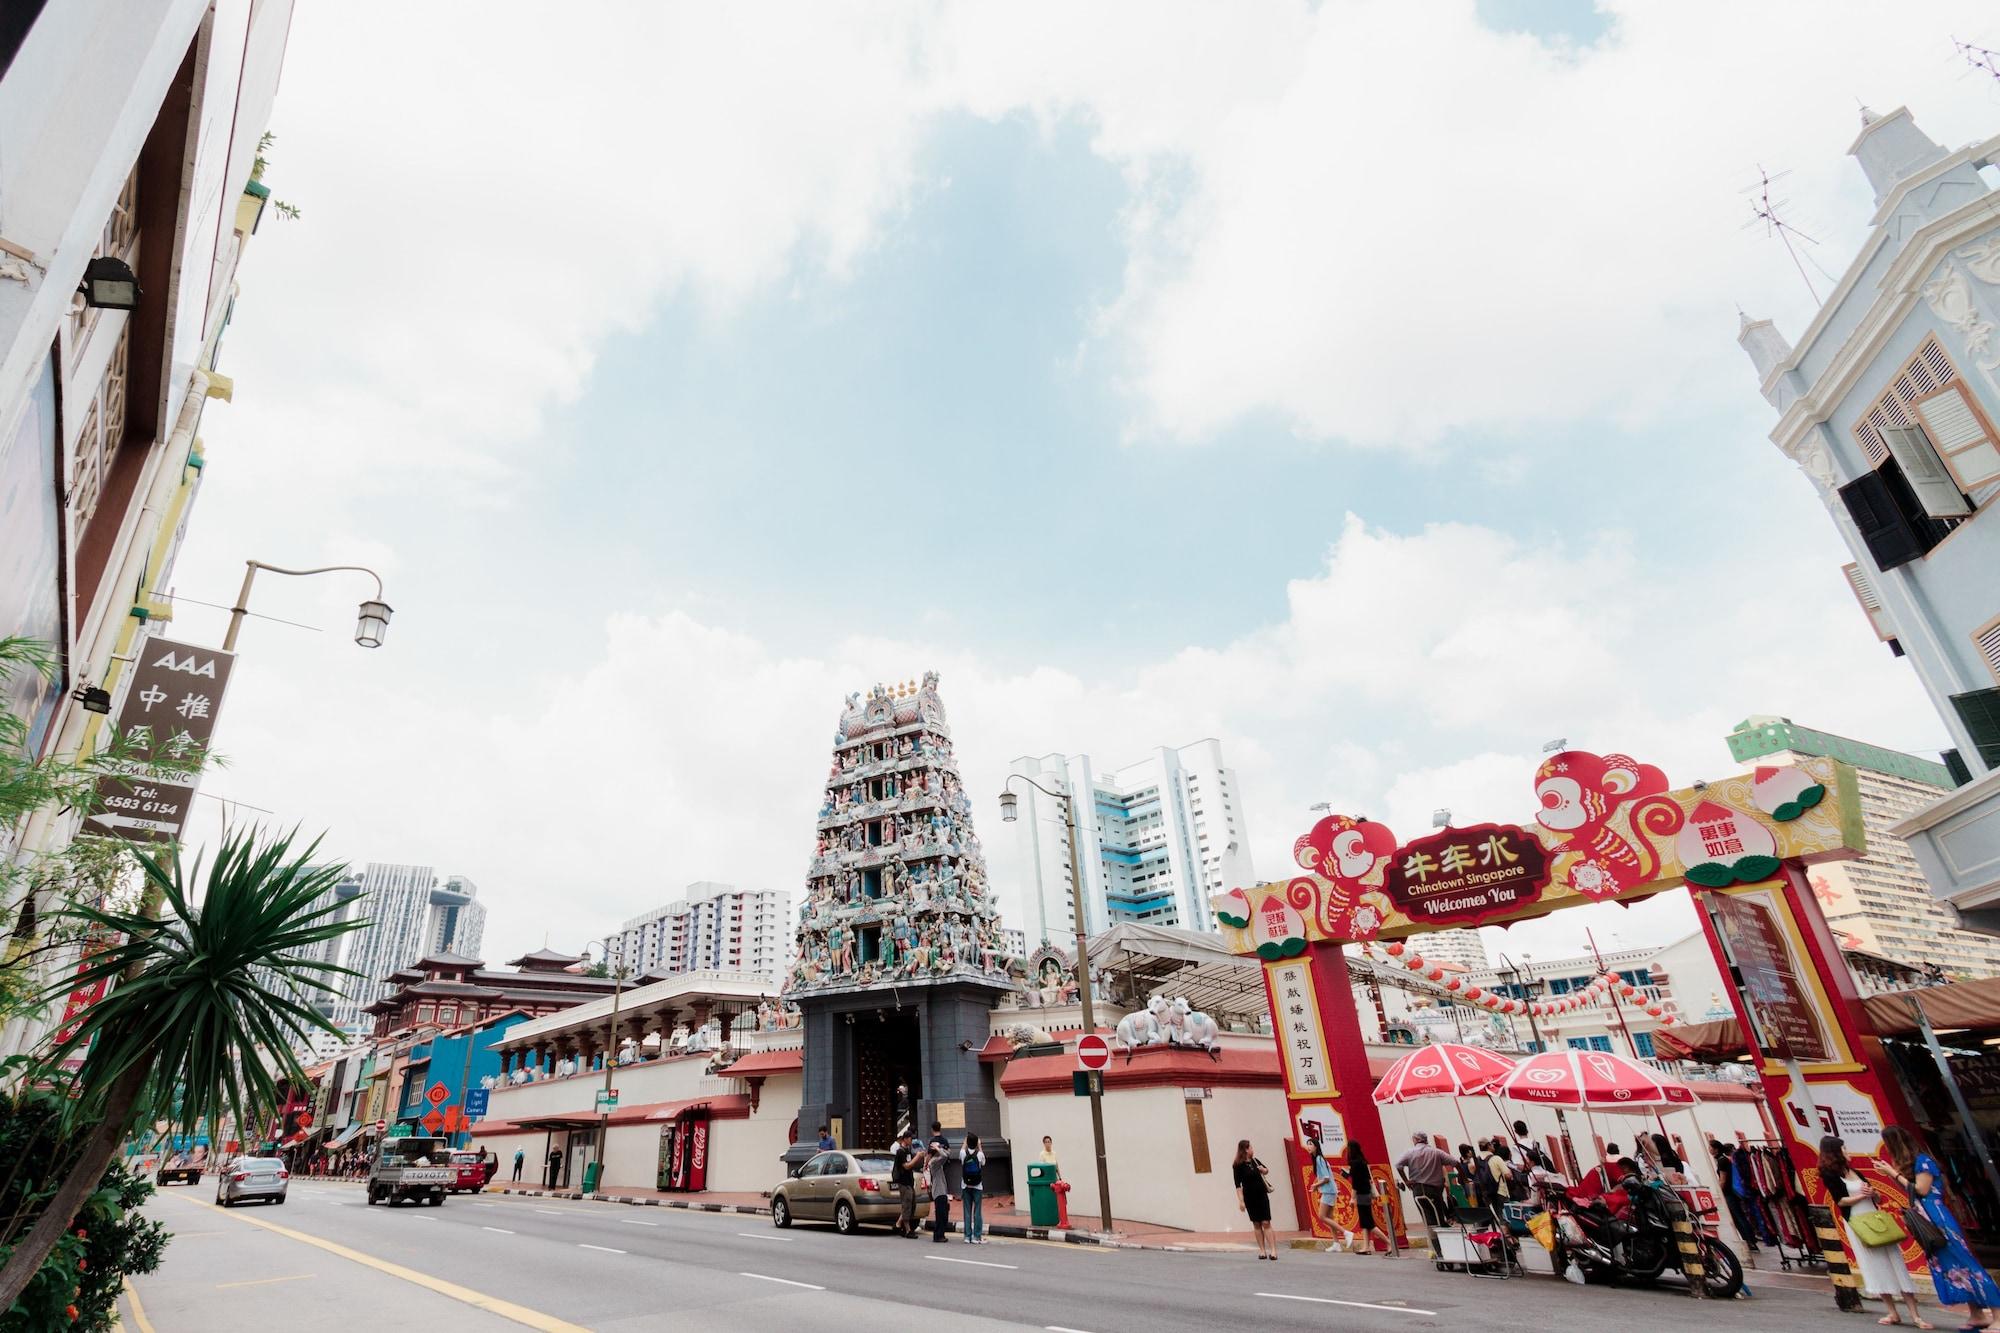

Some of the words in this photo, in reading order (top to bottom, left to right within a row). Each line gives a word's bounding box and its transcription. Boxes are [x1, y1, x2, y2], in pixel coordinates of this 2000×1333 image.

[152, 651, 215, 679] AAA
[133, 786, 158, 799] Tel:
[104, 796, 140, 809] 6583
[142, 801, 178, 815] 6154
[1705, 838, 1744, 857] 如意
[1403, 834, 1520, 882] 牛车水
[1407, 878, 1465, 896] Chinatown
[1465, 864, 1525, 884] Singapore
[1423, 895, 1487, 915] Welcomes
[1488, 887, 1516, 902] You
[1527, 1087, 1557, 1098] WALL'S
[411, 1171, 448, 1179] TOYOTA
